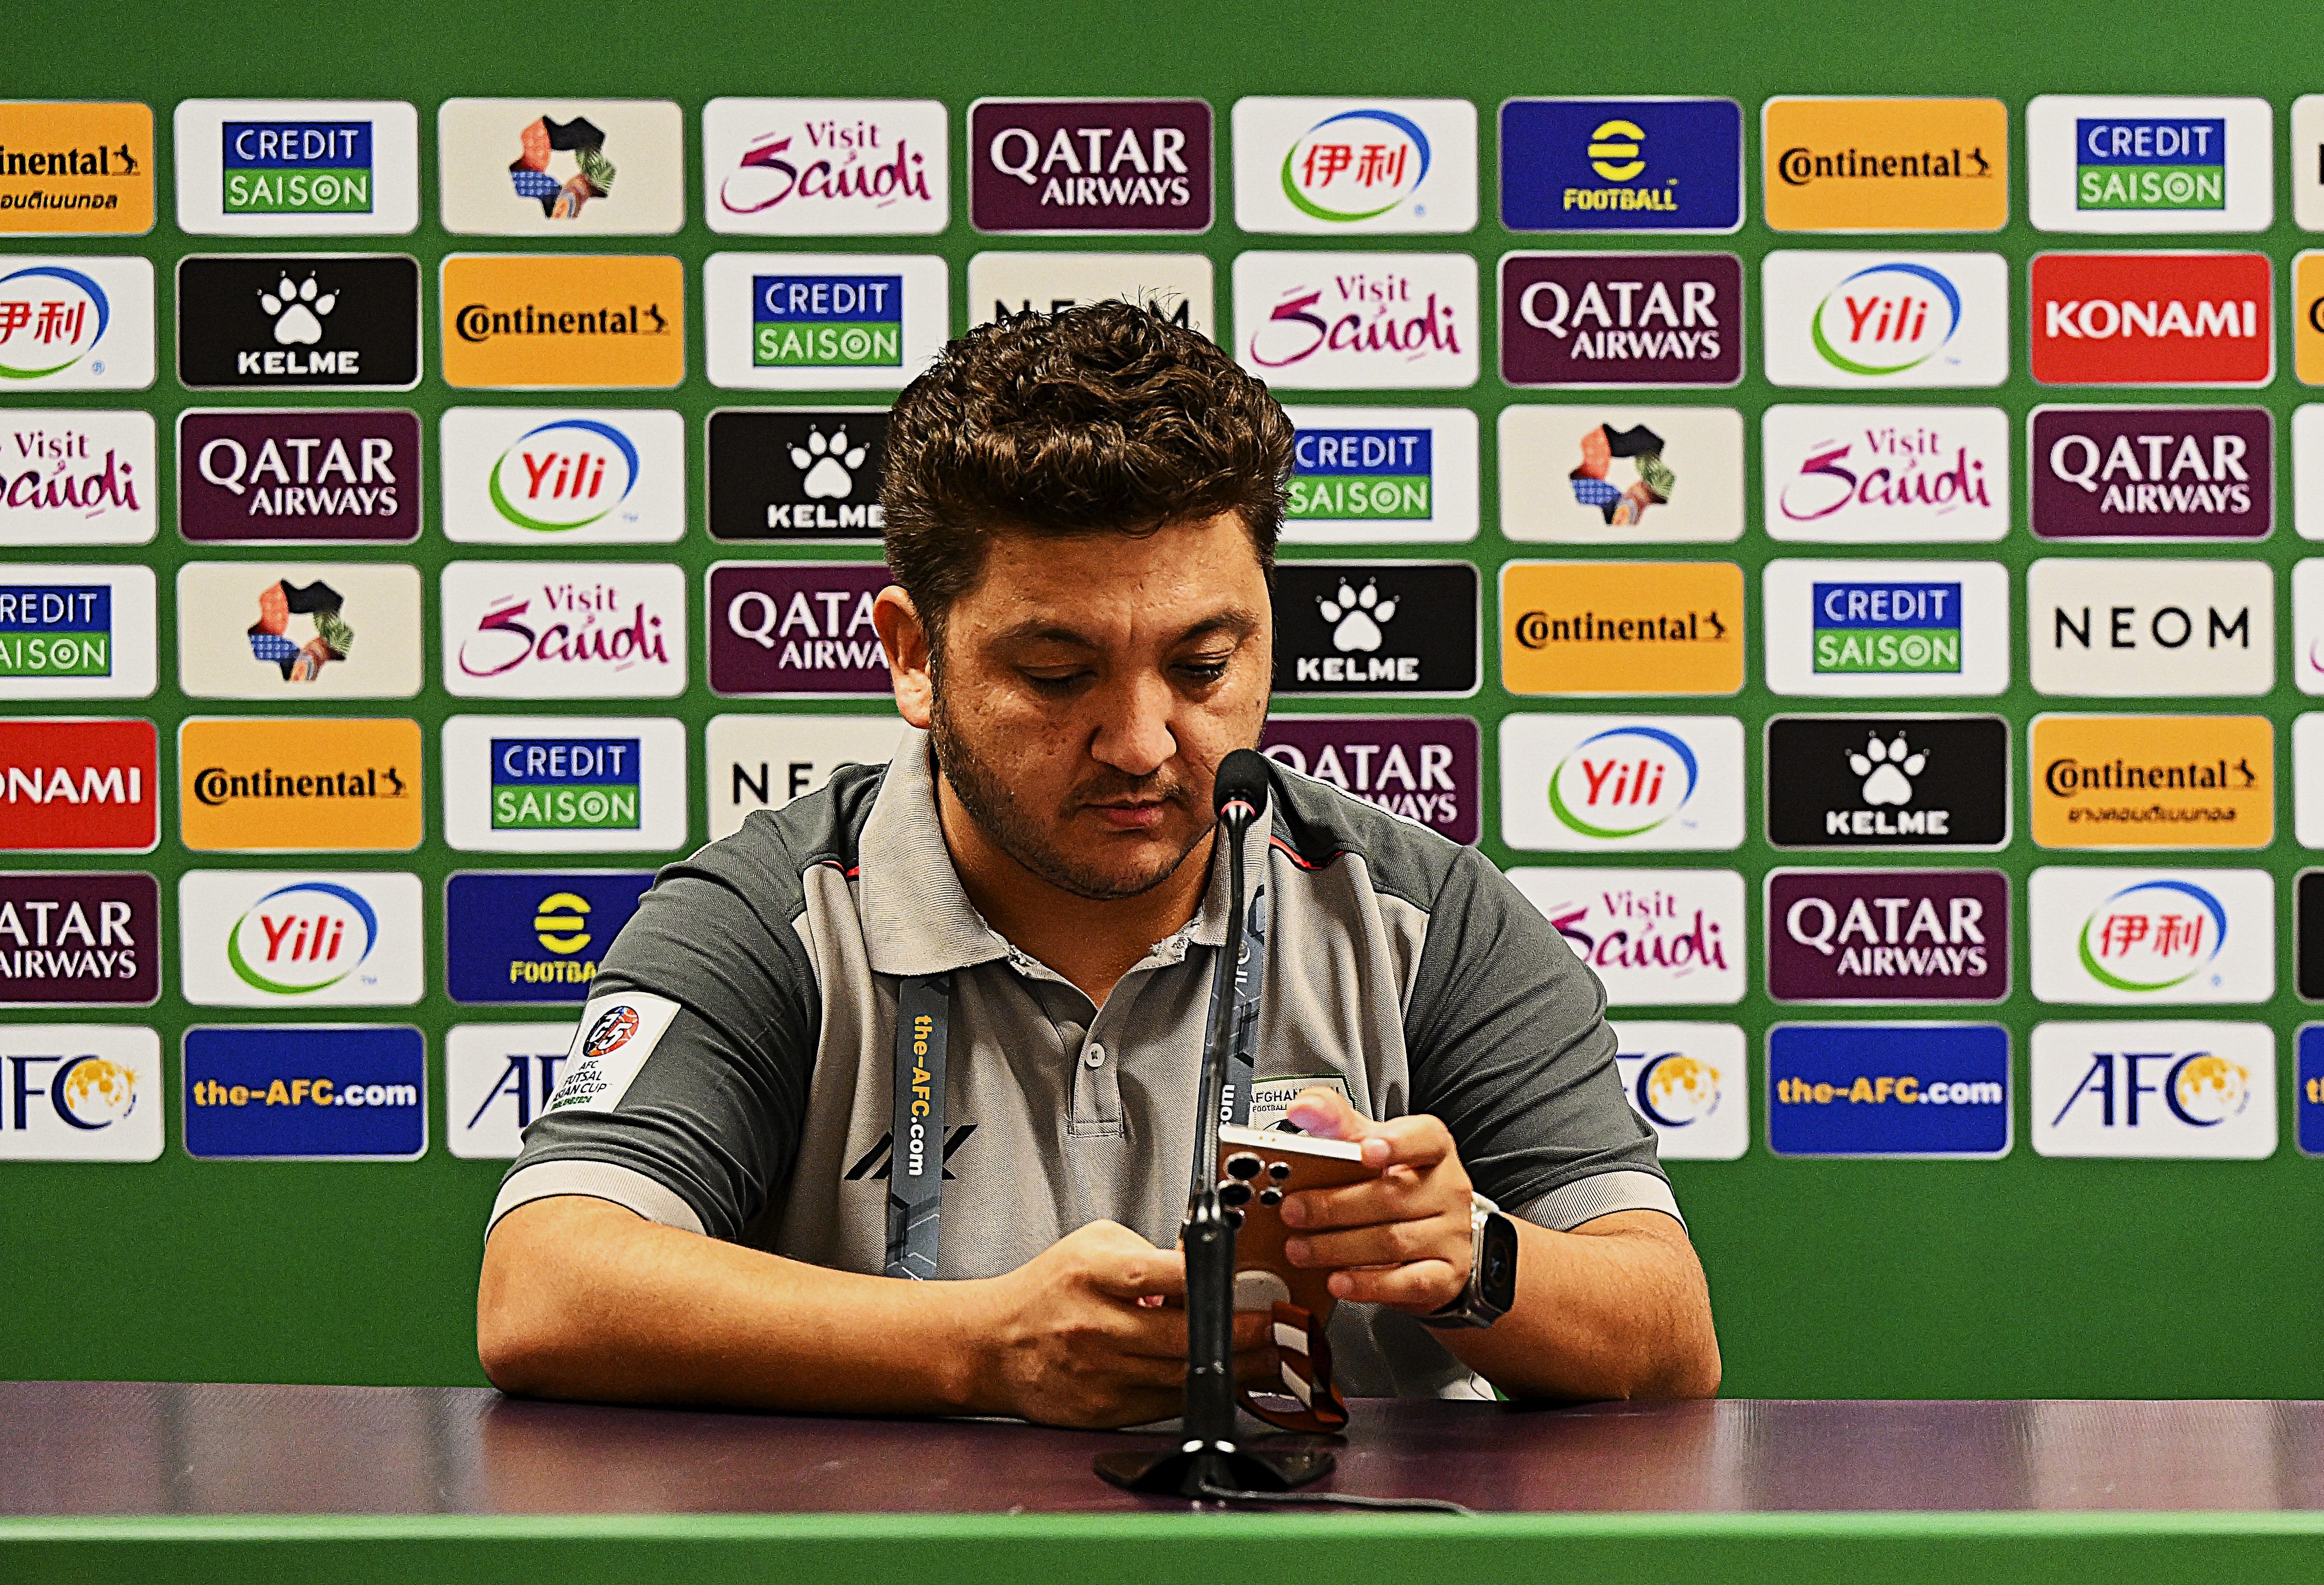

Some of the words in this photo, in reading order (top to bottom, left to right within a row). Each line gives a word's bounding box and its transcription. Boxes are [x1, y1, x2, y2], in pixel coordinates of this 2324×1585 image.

[236, 130, 359, 160] CREDIT
[807, 122, 878, 149] Visit
[2089, 126, 2212, 158] CREDIT
[720, 130, 931, 214] Saudi
[991, 128, 1188, 185] QATAR
[1302, 144, 1408, 188] 伊利
[1779, 148, 1961, 186] Continental
[228, 172, 367, 207] SAISON
[1040, 177, 1190, 206] AIRWAYS
[1564, 188, 1678, 211] FOOTBALL
[2081, 169, 2222, 204] SAISON
[766, 282, 889, 315] CREDIT
[1336, 275, 1412, 302] Visit
[456, 305, 638, 343] Continental
[1251, 285, 1462, 368] Saudi
[1521, 282, 1719, 339] QATAR
[1846, 297, 1928, 343] Yili
[2047, 300, 2257, 339] KONAMI
[758, 326, 897, 361] SAISON
[1571, 331, 1721, 360] AIRWAYS
[238, 351, 360, 375] KELME
[15, 432, 90, 458] Visit
[1295, 435, 1419, 471] CREDIT
[1867, 429, 1938, 454] Visit
[200, 438, 396, 495] QATAR
[523, 453, 606, 500] Yili
[1779, 438, 1991, 522] Saudi
[2050, 435, 2249, 493] QATAR
[0, 448, 141, 519] audi
[1289, 479, 1428, 514] SAISON
[2100, 484, 2251, 514] AIRWAYS
[248, 487, 398, 517] AIRWAYS
[767, 504, 885, 529] KELME
[0, 593, 97, 623] REDIT
[544, 585, 620, 611] Visit
[1825, 590, 1948, 622] CREDIT
[458, 595, 670, 678] Saudi
[728, 591, 880, 649] QATA
[1516, 612, 1697, 650] Continental
[2056, 607, 2249, 649] NEOM
[0, 639, 105, 669] AISON
[779, 640, 890, 669] AIRWA
[1818, 633, 1958, 669] SAISON
[1297, 658, 1419, 682] KELME
[504, 745, 626, 777] CREDIT
[2046, 759, 2227, 798] Continental
[0, 767, 141, 804] NAMI
[195, 768, 376, 806] Continental
[1582, 760, 1665, 806] Yili
[497, 787, 635, 823] SAISON
[1827, 811, 1950, 835] KELME
[1603, 892, 1676, 918] Visit
[0, 901, 135, 946] ATAR
[261, 916, 345, 962] Yili
[1787, 898, 1985, 955] QATAR
[2102, 915, 2204, 958] 伊利
[510, 960, 597, 984] FOOTBA
[1838, 947, 1988, 976] AIRWAYS
[564, 1070, 602, 1086] FUTSAL
[579, 1060, 599, 1071] AFC
[0, 1053, 138, 1131] FC
[194, 1080, 417, 1107] the-AFC.com
[580, 1083, 607, 1094] CUP
[909, 1014, 933, 1176] the-AFC.com
[1778, 1077, 2003, 1105] the-AFC.com
[2053, 1051, 2250, 1128] AFC
